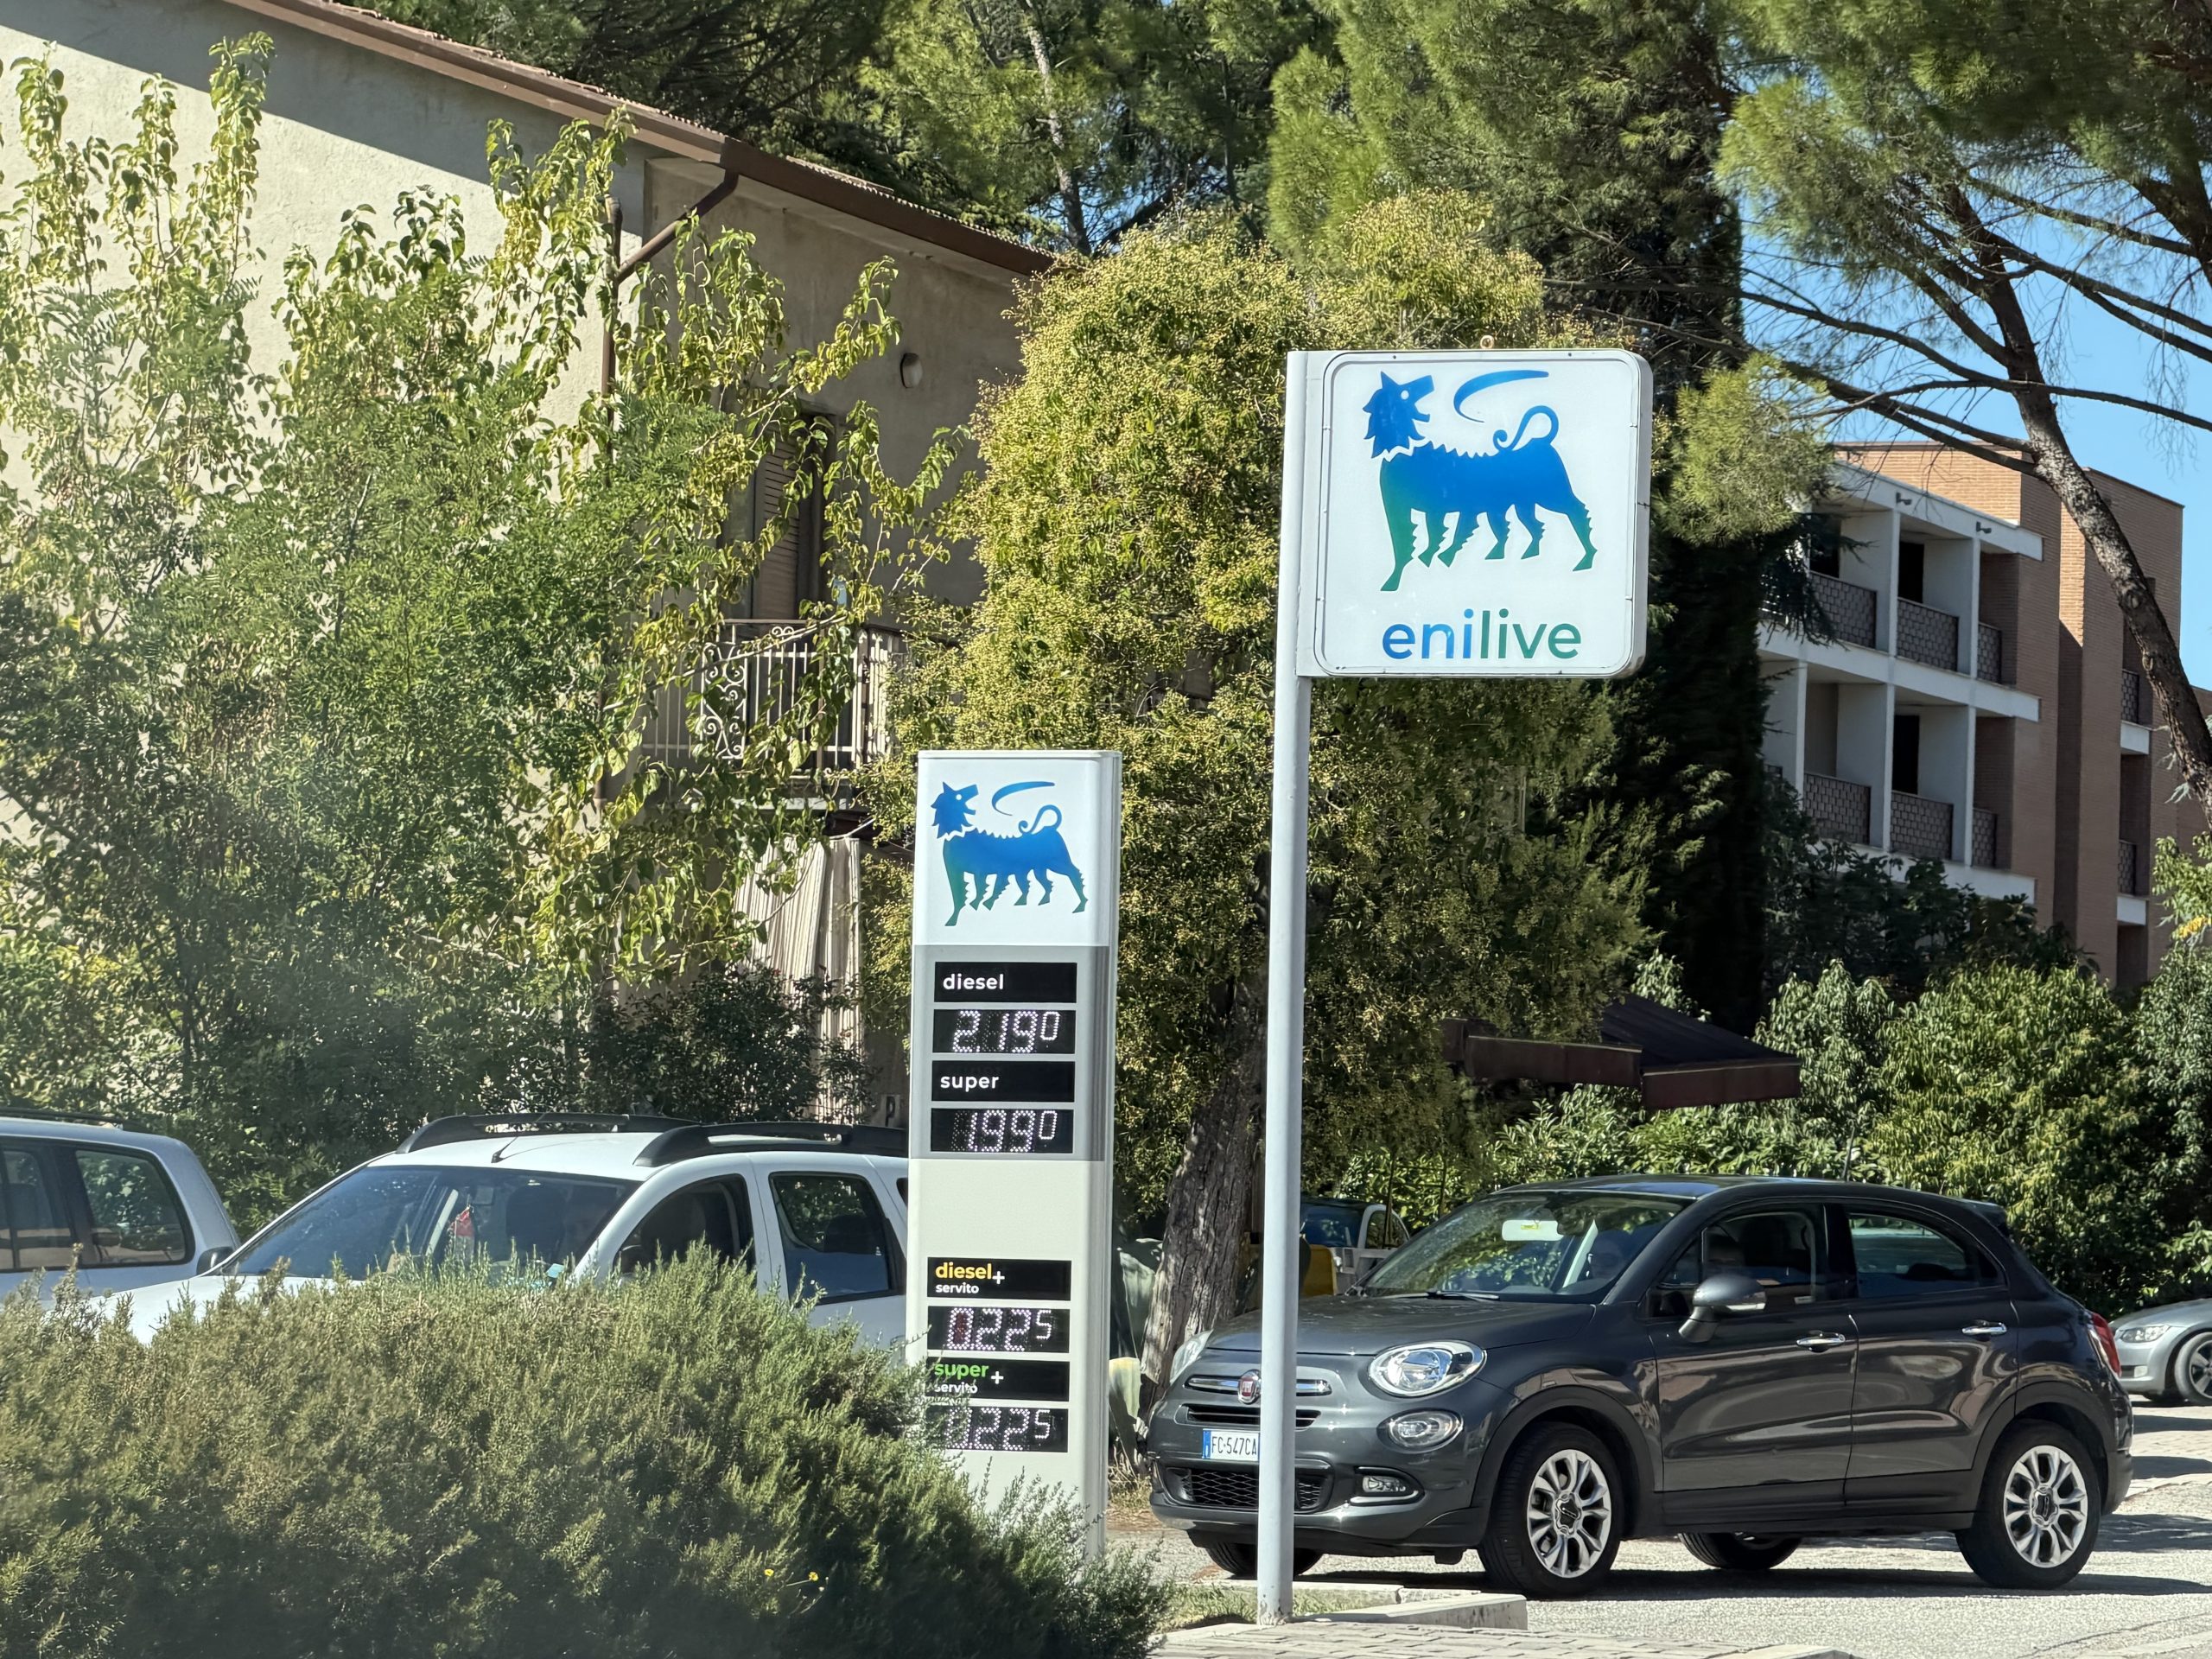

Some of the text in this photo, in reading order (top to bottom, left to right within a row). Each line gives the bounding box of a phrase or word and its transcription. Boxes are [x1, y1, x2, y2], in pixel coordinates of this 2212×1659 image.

[1382, 608, 1581, 659] enilive
[943, 973, 1004, 990] diesel
[940, 1075, 1000, 1092] super
[935, 1282, 980, 1294] servito
